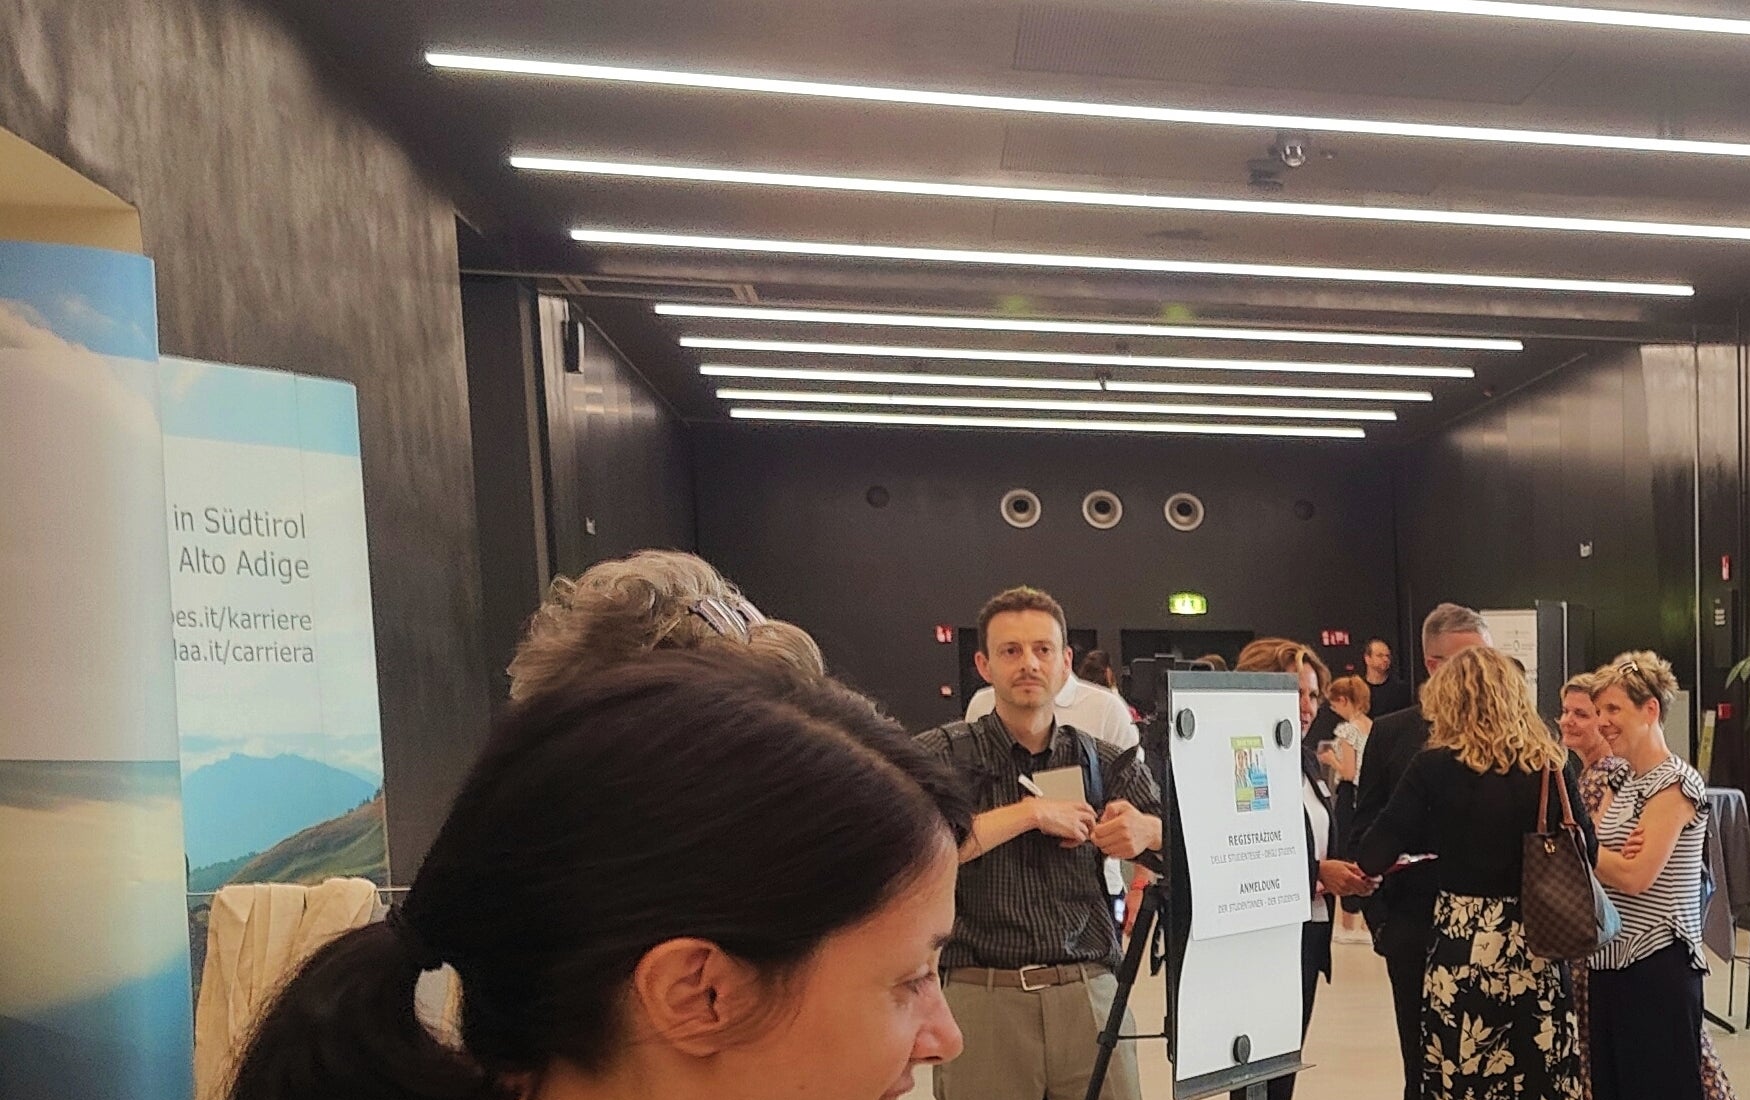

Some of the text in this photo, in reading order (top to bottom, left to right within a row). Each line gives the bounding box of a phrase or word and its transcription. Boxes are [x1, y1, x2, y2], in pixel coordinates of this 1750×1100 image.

[173, 504, 307, 539] in Südtirol
[178, 546, 310, 584] Alto Adige
[1228, 830, 1282, 846] REGISTRAZIONE
[1239, 878, 1280, 894] ANMELDUNG
